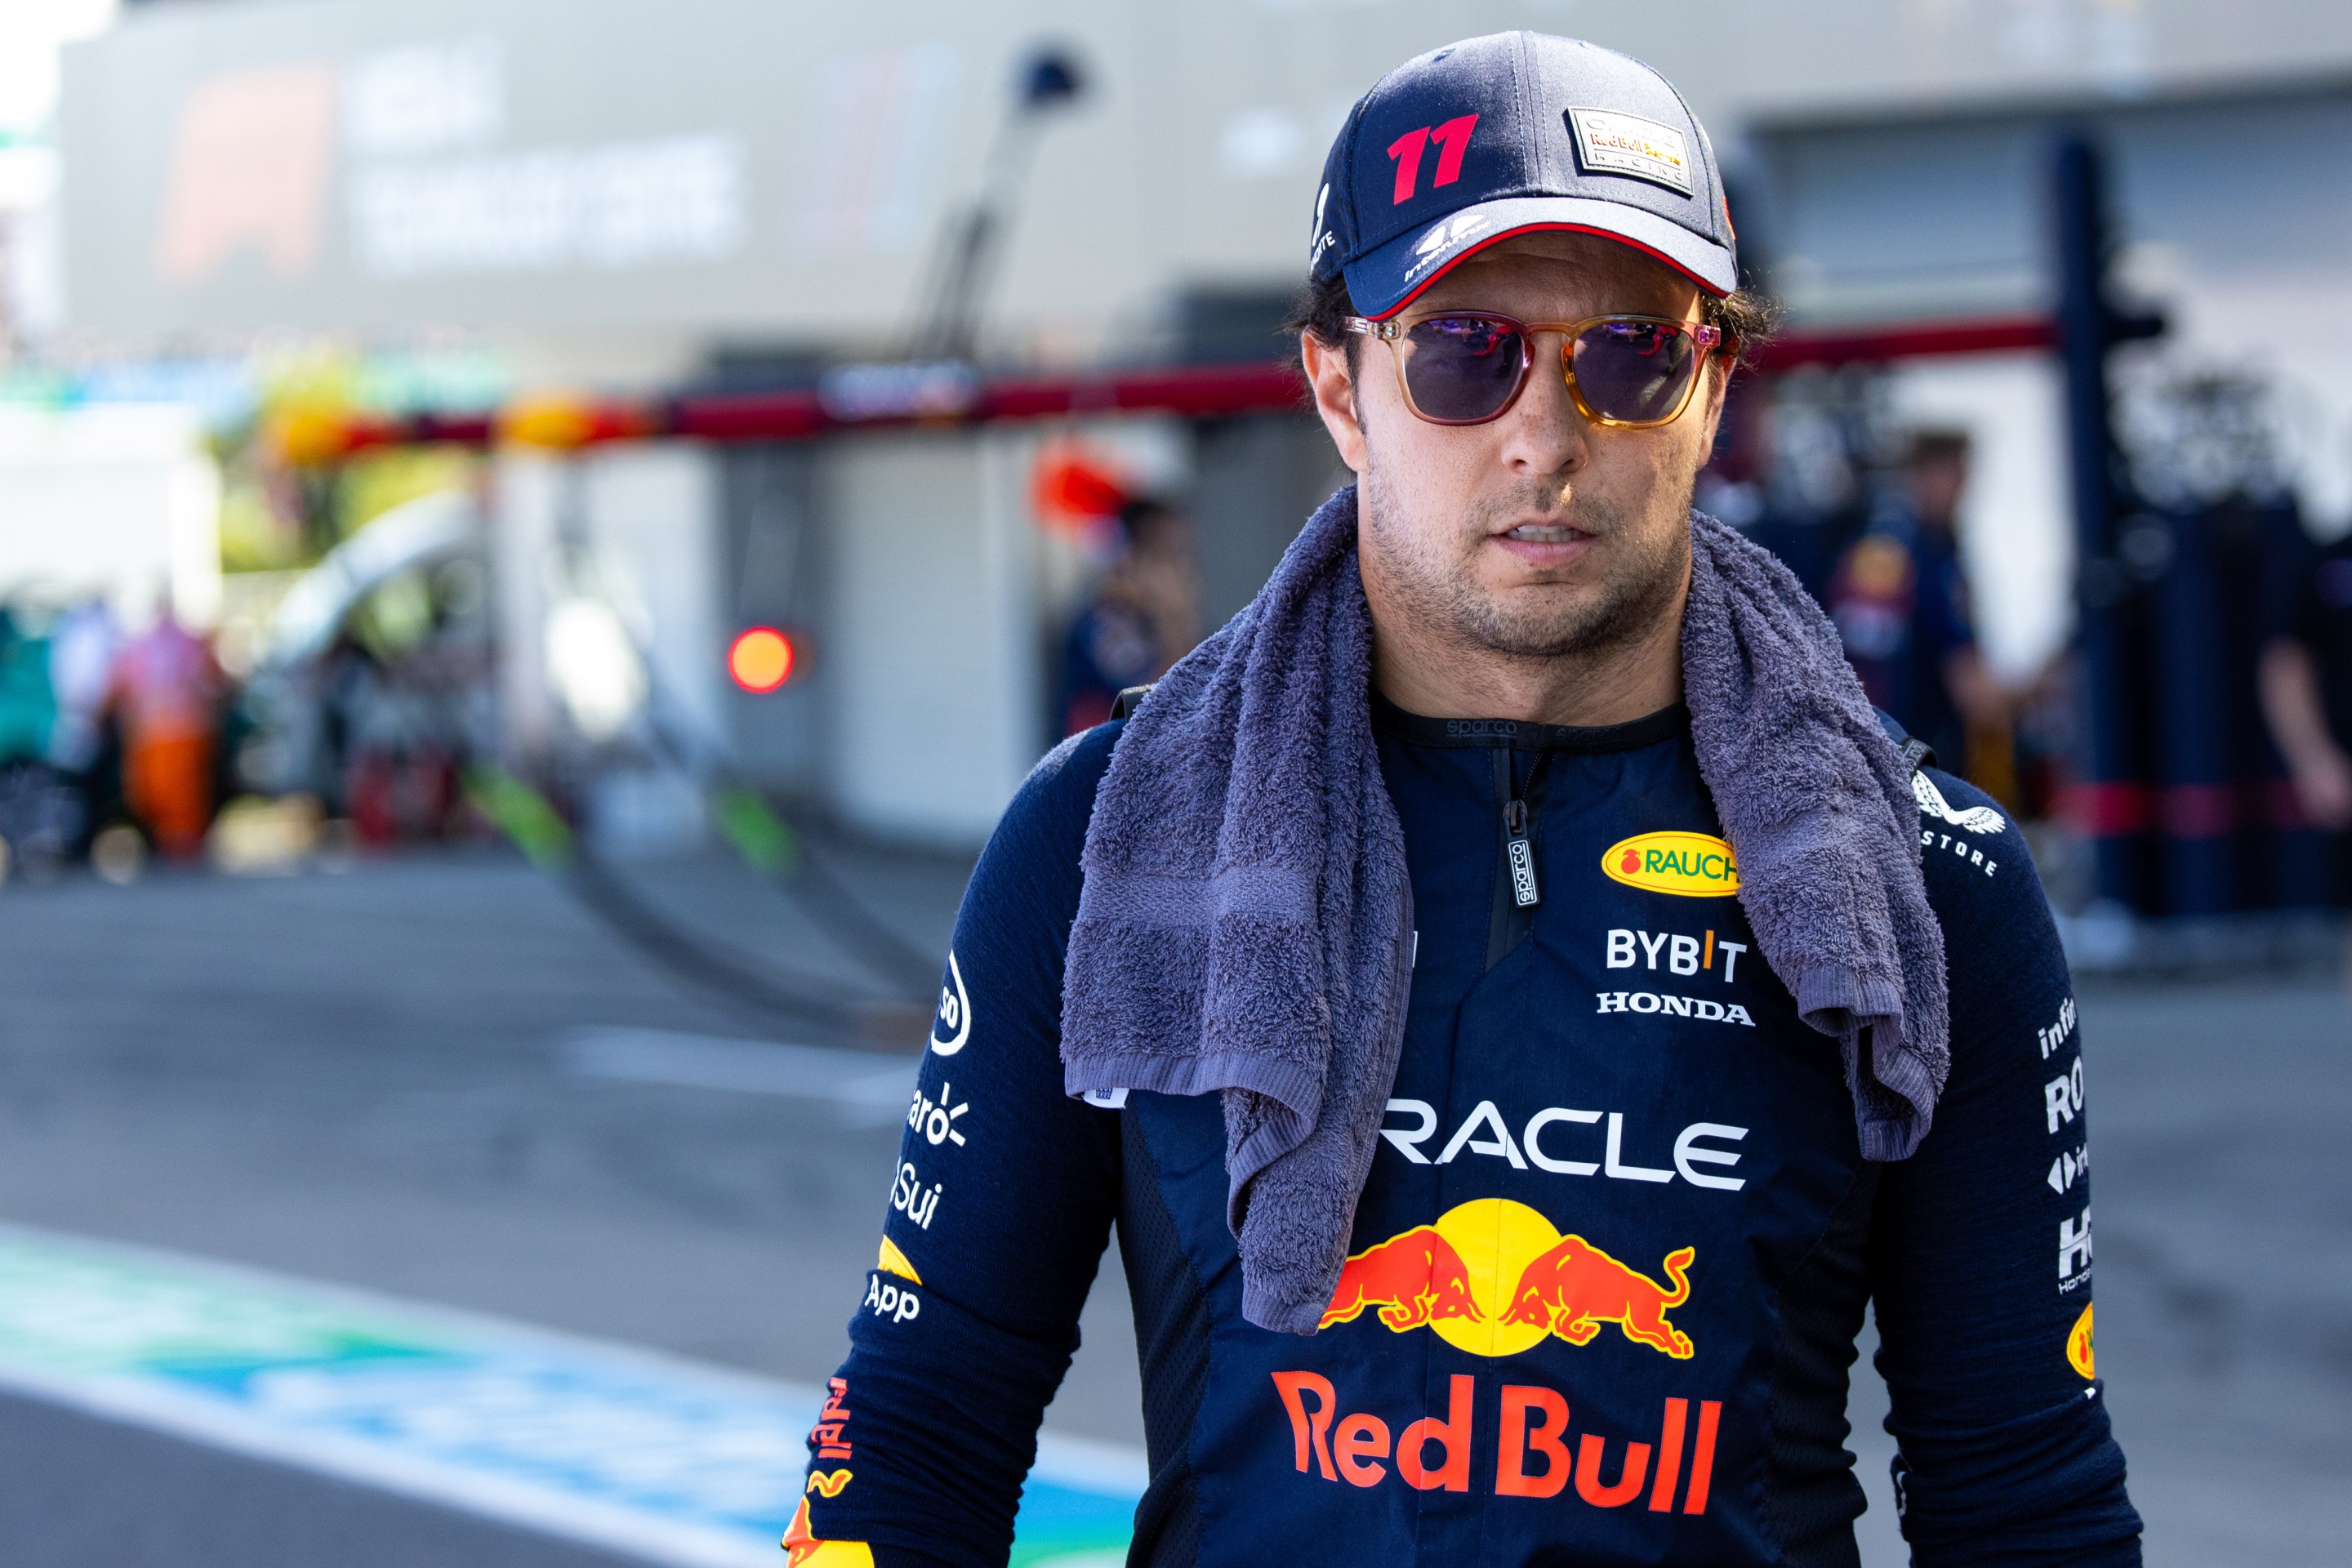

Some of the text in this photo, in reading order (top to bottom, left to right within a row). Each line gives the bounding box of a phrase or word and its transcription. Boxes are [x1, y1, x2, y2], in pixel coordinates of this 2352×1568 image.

[1388, 114, 1479, 205] 11
[1310, 230, 1335, 275] NORTE
[1446, 719, 1517, 739] sparco
[1512, 844, 1534, 902] sparco
[1645, 849, 1740, 884] RAUCH
[1921, 831, 1998, 877] STORE
[1606, 929, 1748, 983] BYBIT
[1596, 991, 1756, 1027] HONDA
[907, 1089, 950, 1146] aro
[2044, 1055, 2083, 1134] RO
[1379, 1098, 1749, 1191] RACLE
[894, 1162, 942, 1230] Sui
[864, 1273, 920, 1324] App
[1271, 1370, 1722, 1516] Red Bull
